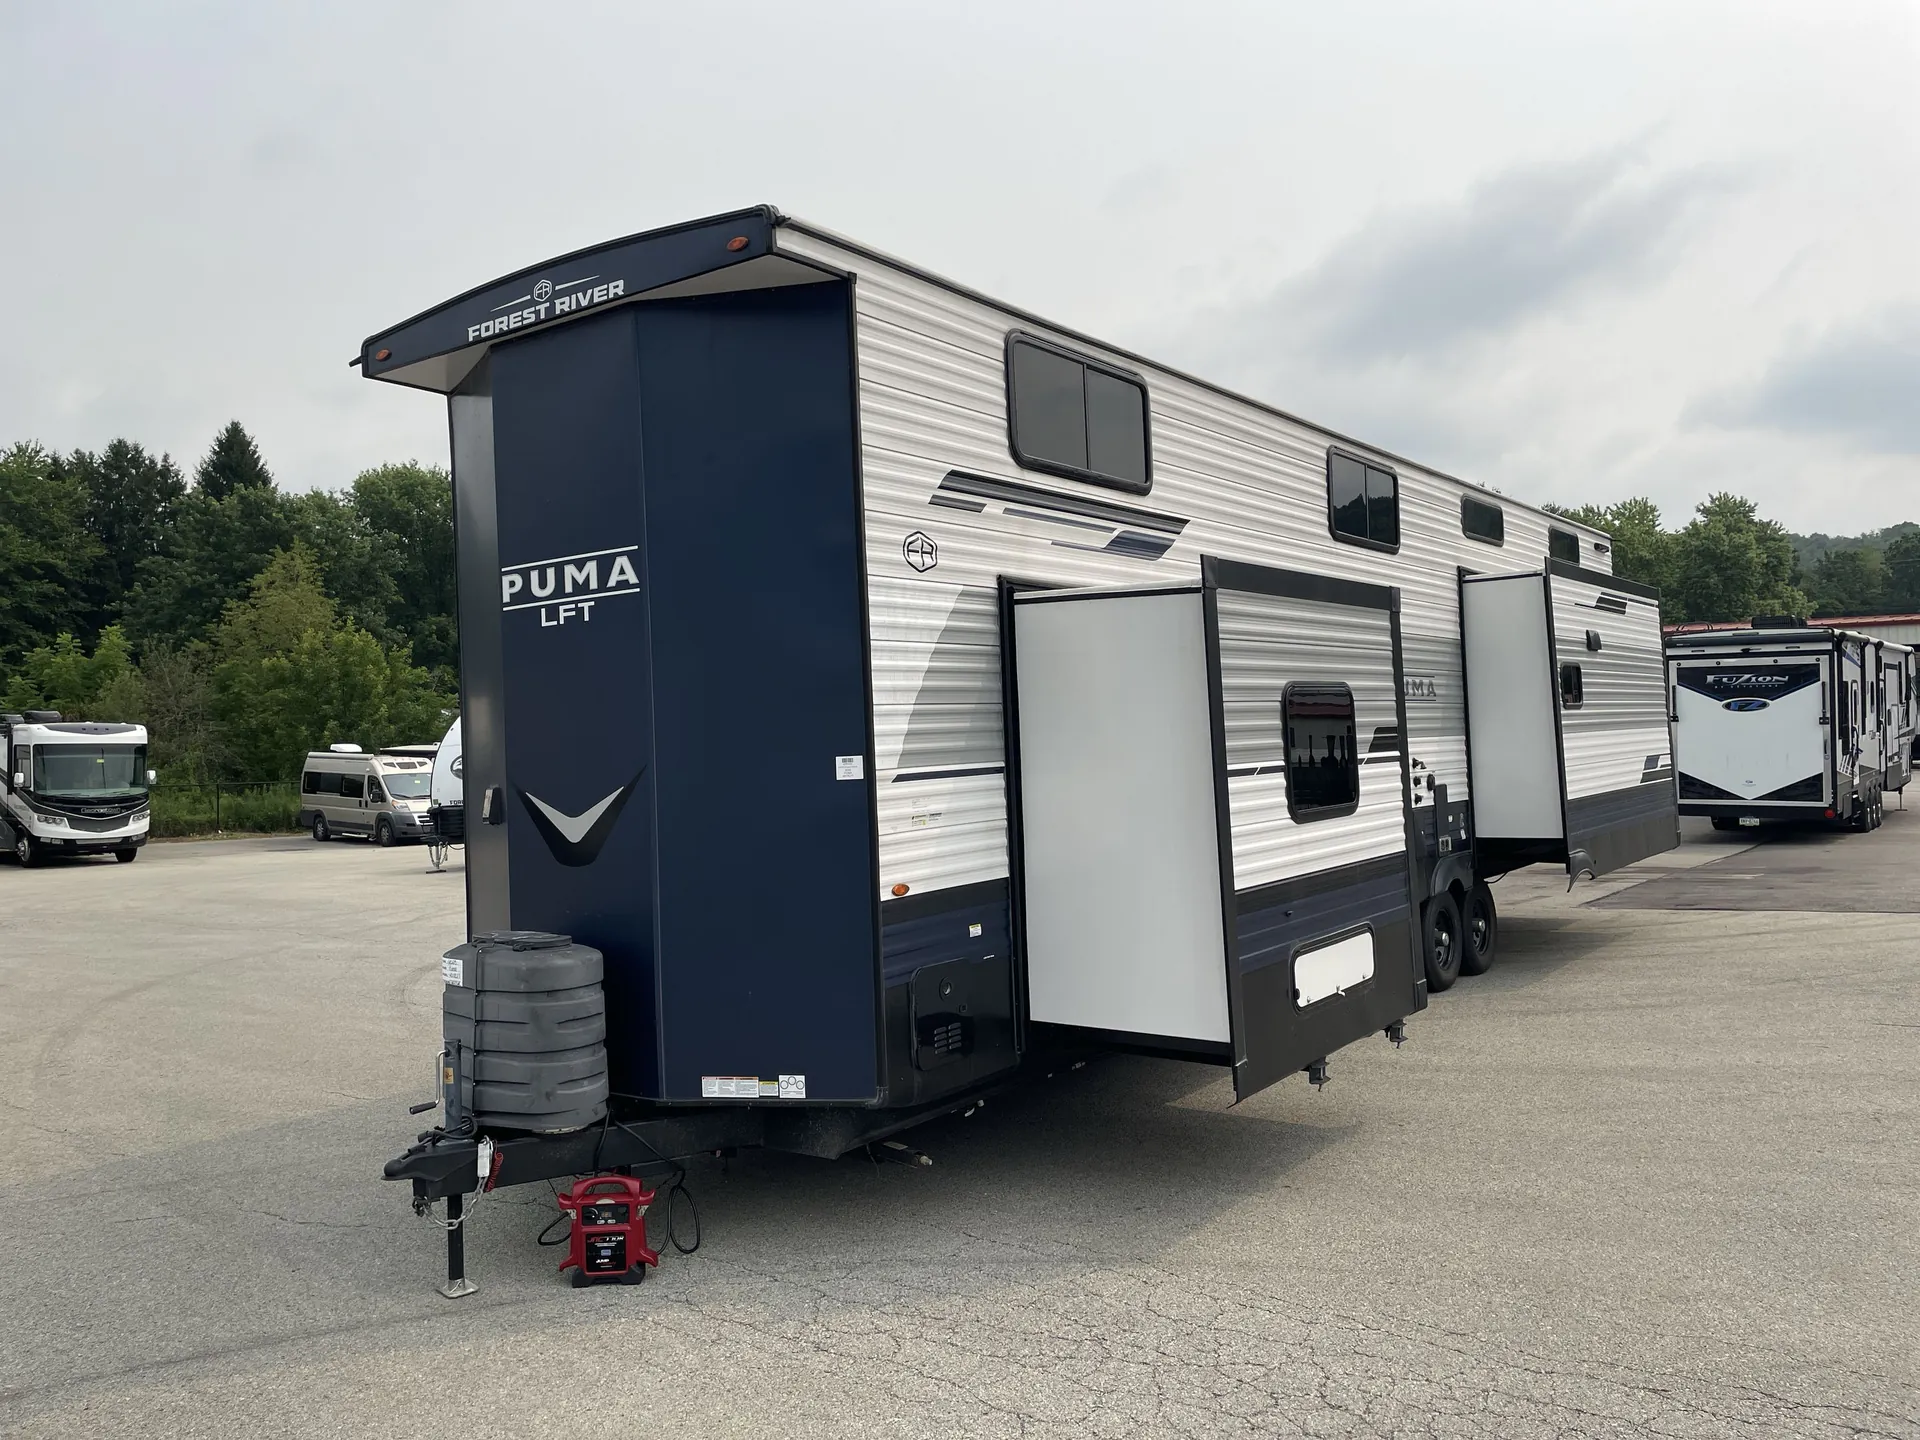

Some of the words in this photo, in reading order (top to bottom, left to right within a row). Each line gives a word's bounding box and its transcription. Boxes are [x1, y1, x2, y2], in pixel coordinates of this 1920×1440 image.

[467, 302, 550, 342] FOREST
[554, 279, 625, 315] RIVER
[501, 555, 640, 603] PUMA
[540, 601, 595, 627] LFT
[1403, 679, 1436, 696] UMA
